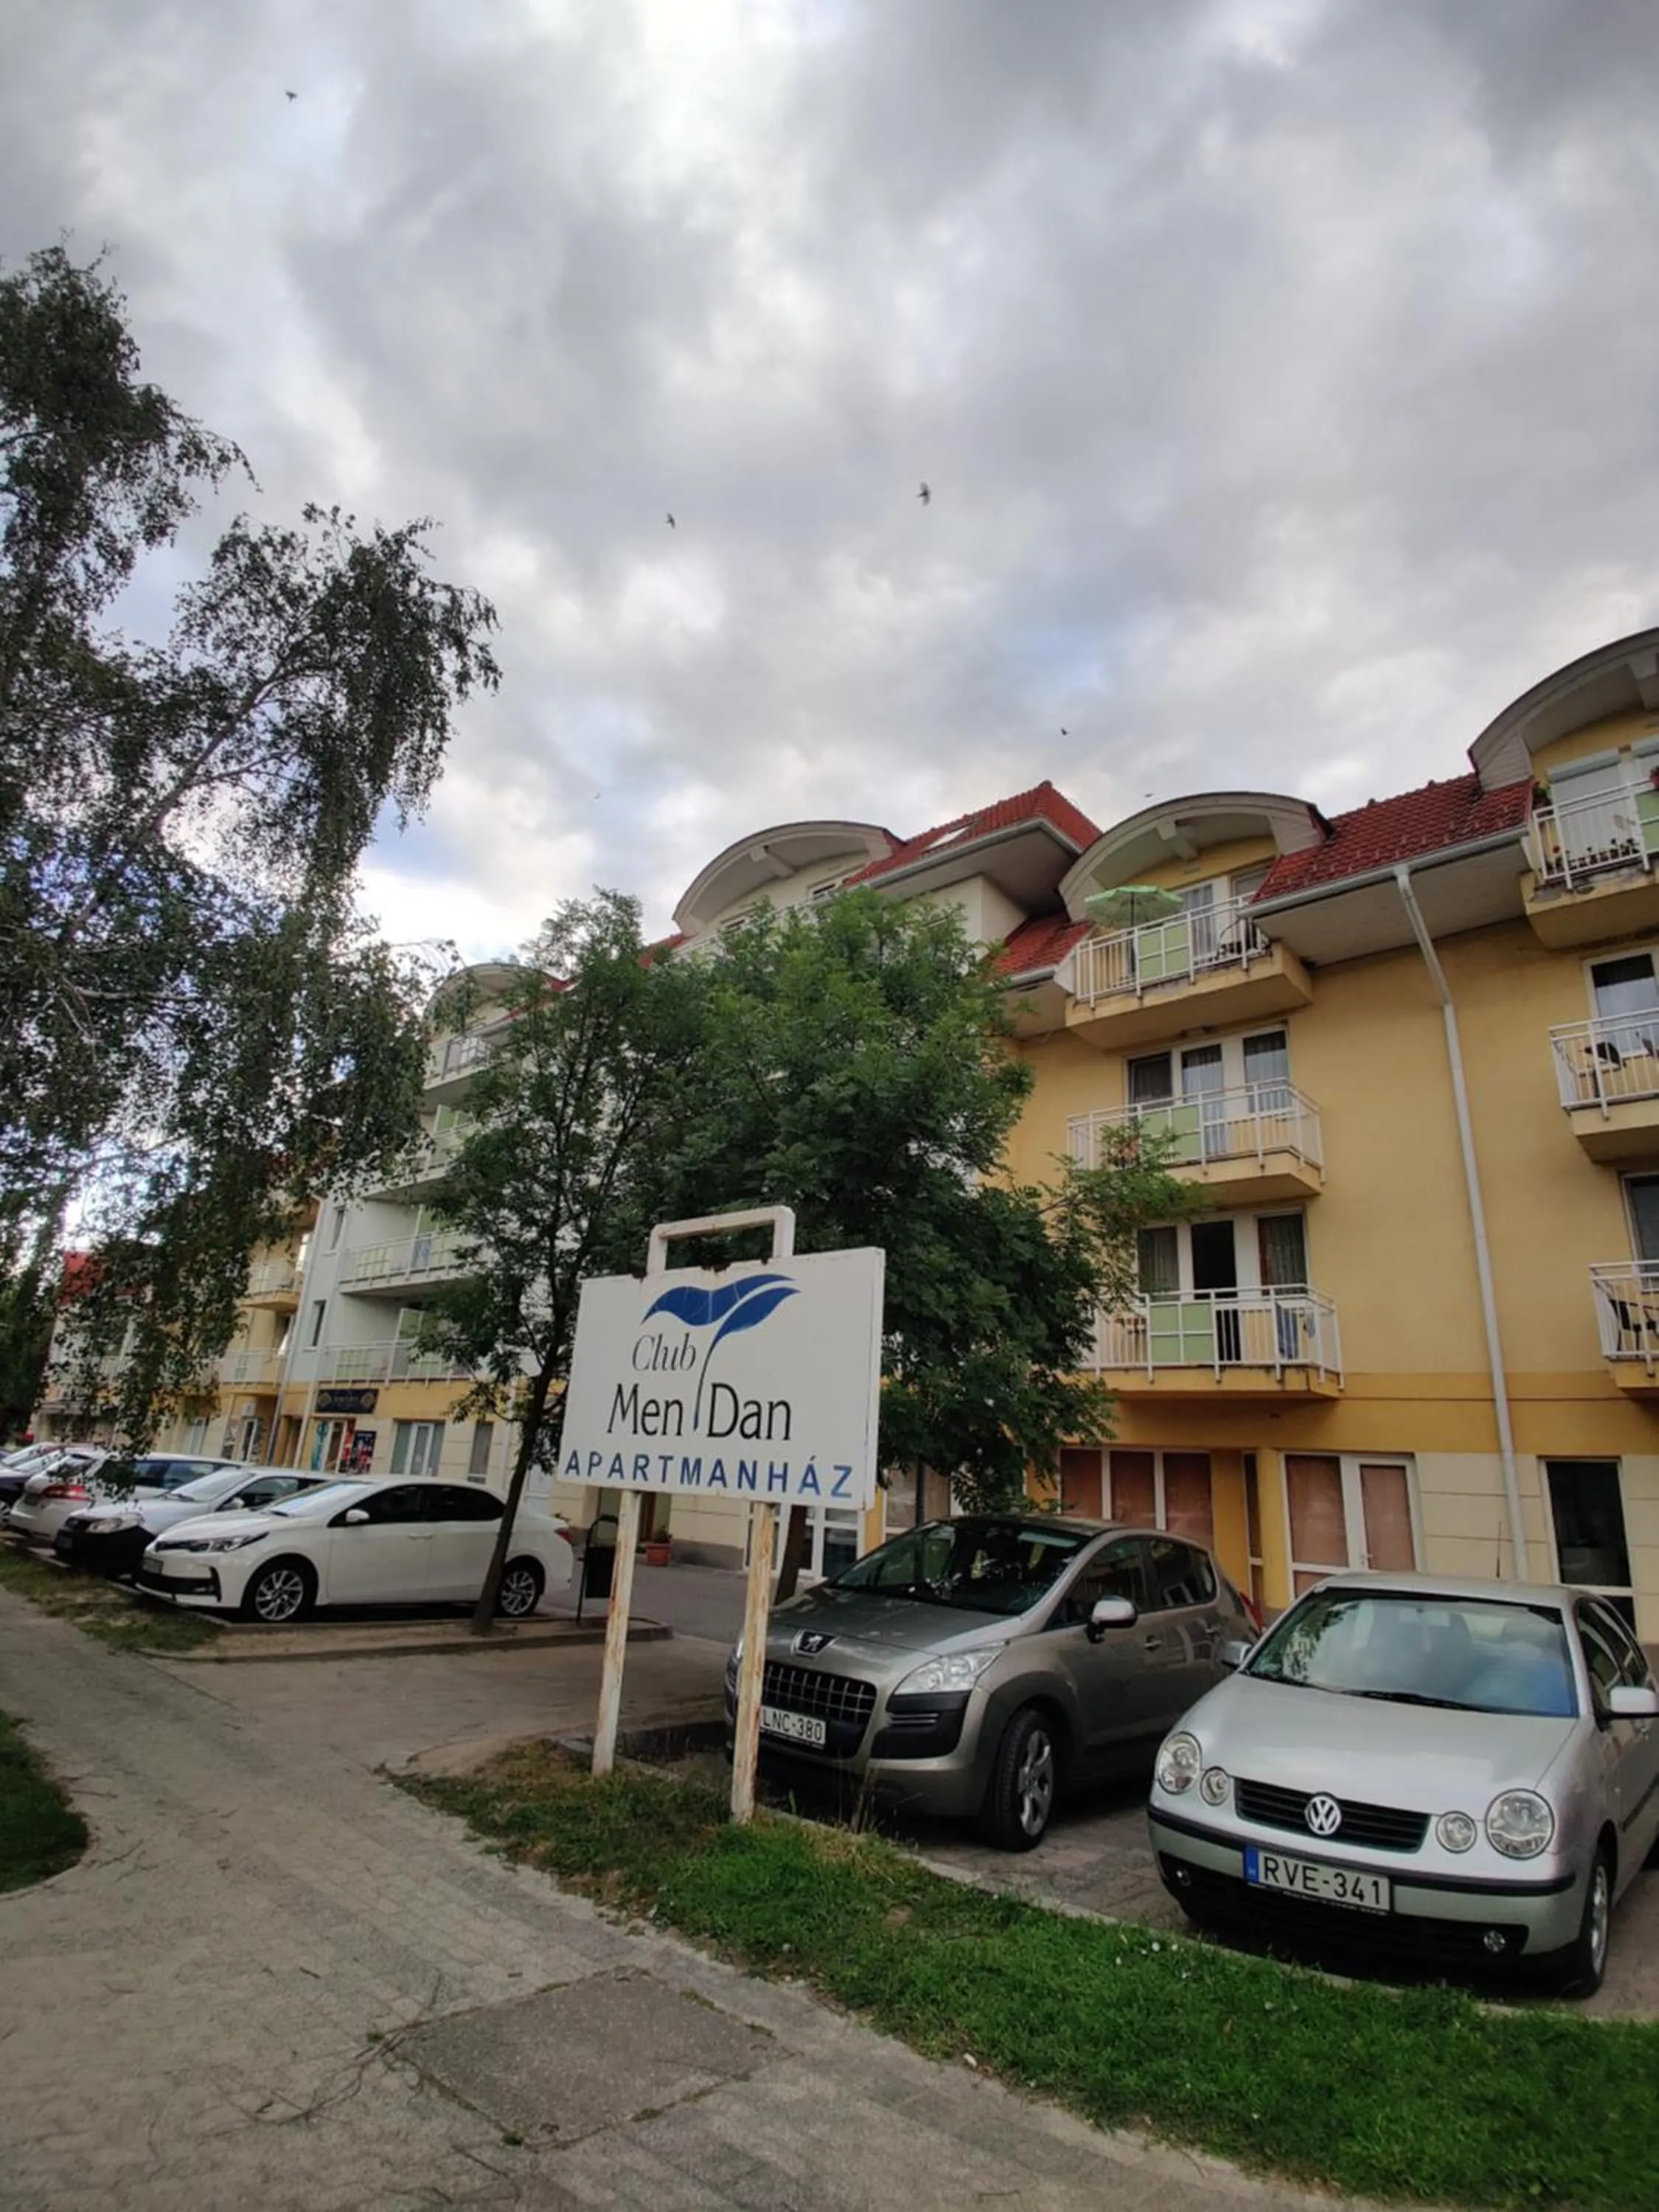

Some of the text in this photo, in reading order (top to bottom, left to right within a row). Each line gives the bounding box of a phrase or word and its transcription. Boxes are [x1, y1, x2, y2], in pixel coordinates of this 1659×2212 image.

[632, 1332, 697, 1371] Club
[607, 1382, 791, 1441] Men Dan
[565, 1449, 852, 1498] APARTMANHÁZ
[762, 1708, 824, 1741] LNC-380
[1263, 1856, 1380, 1905] RVE-341
